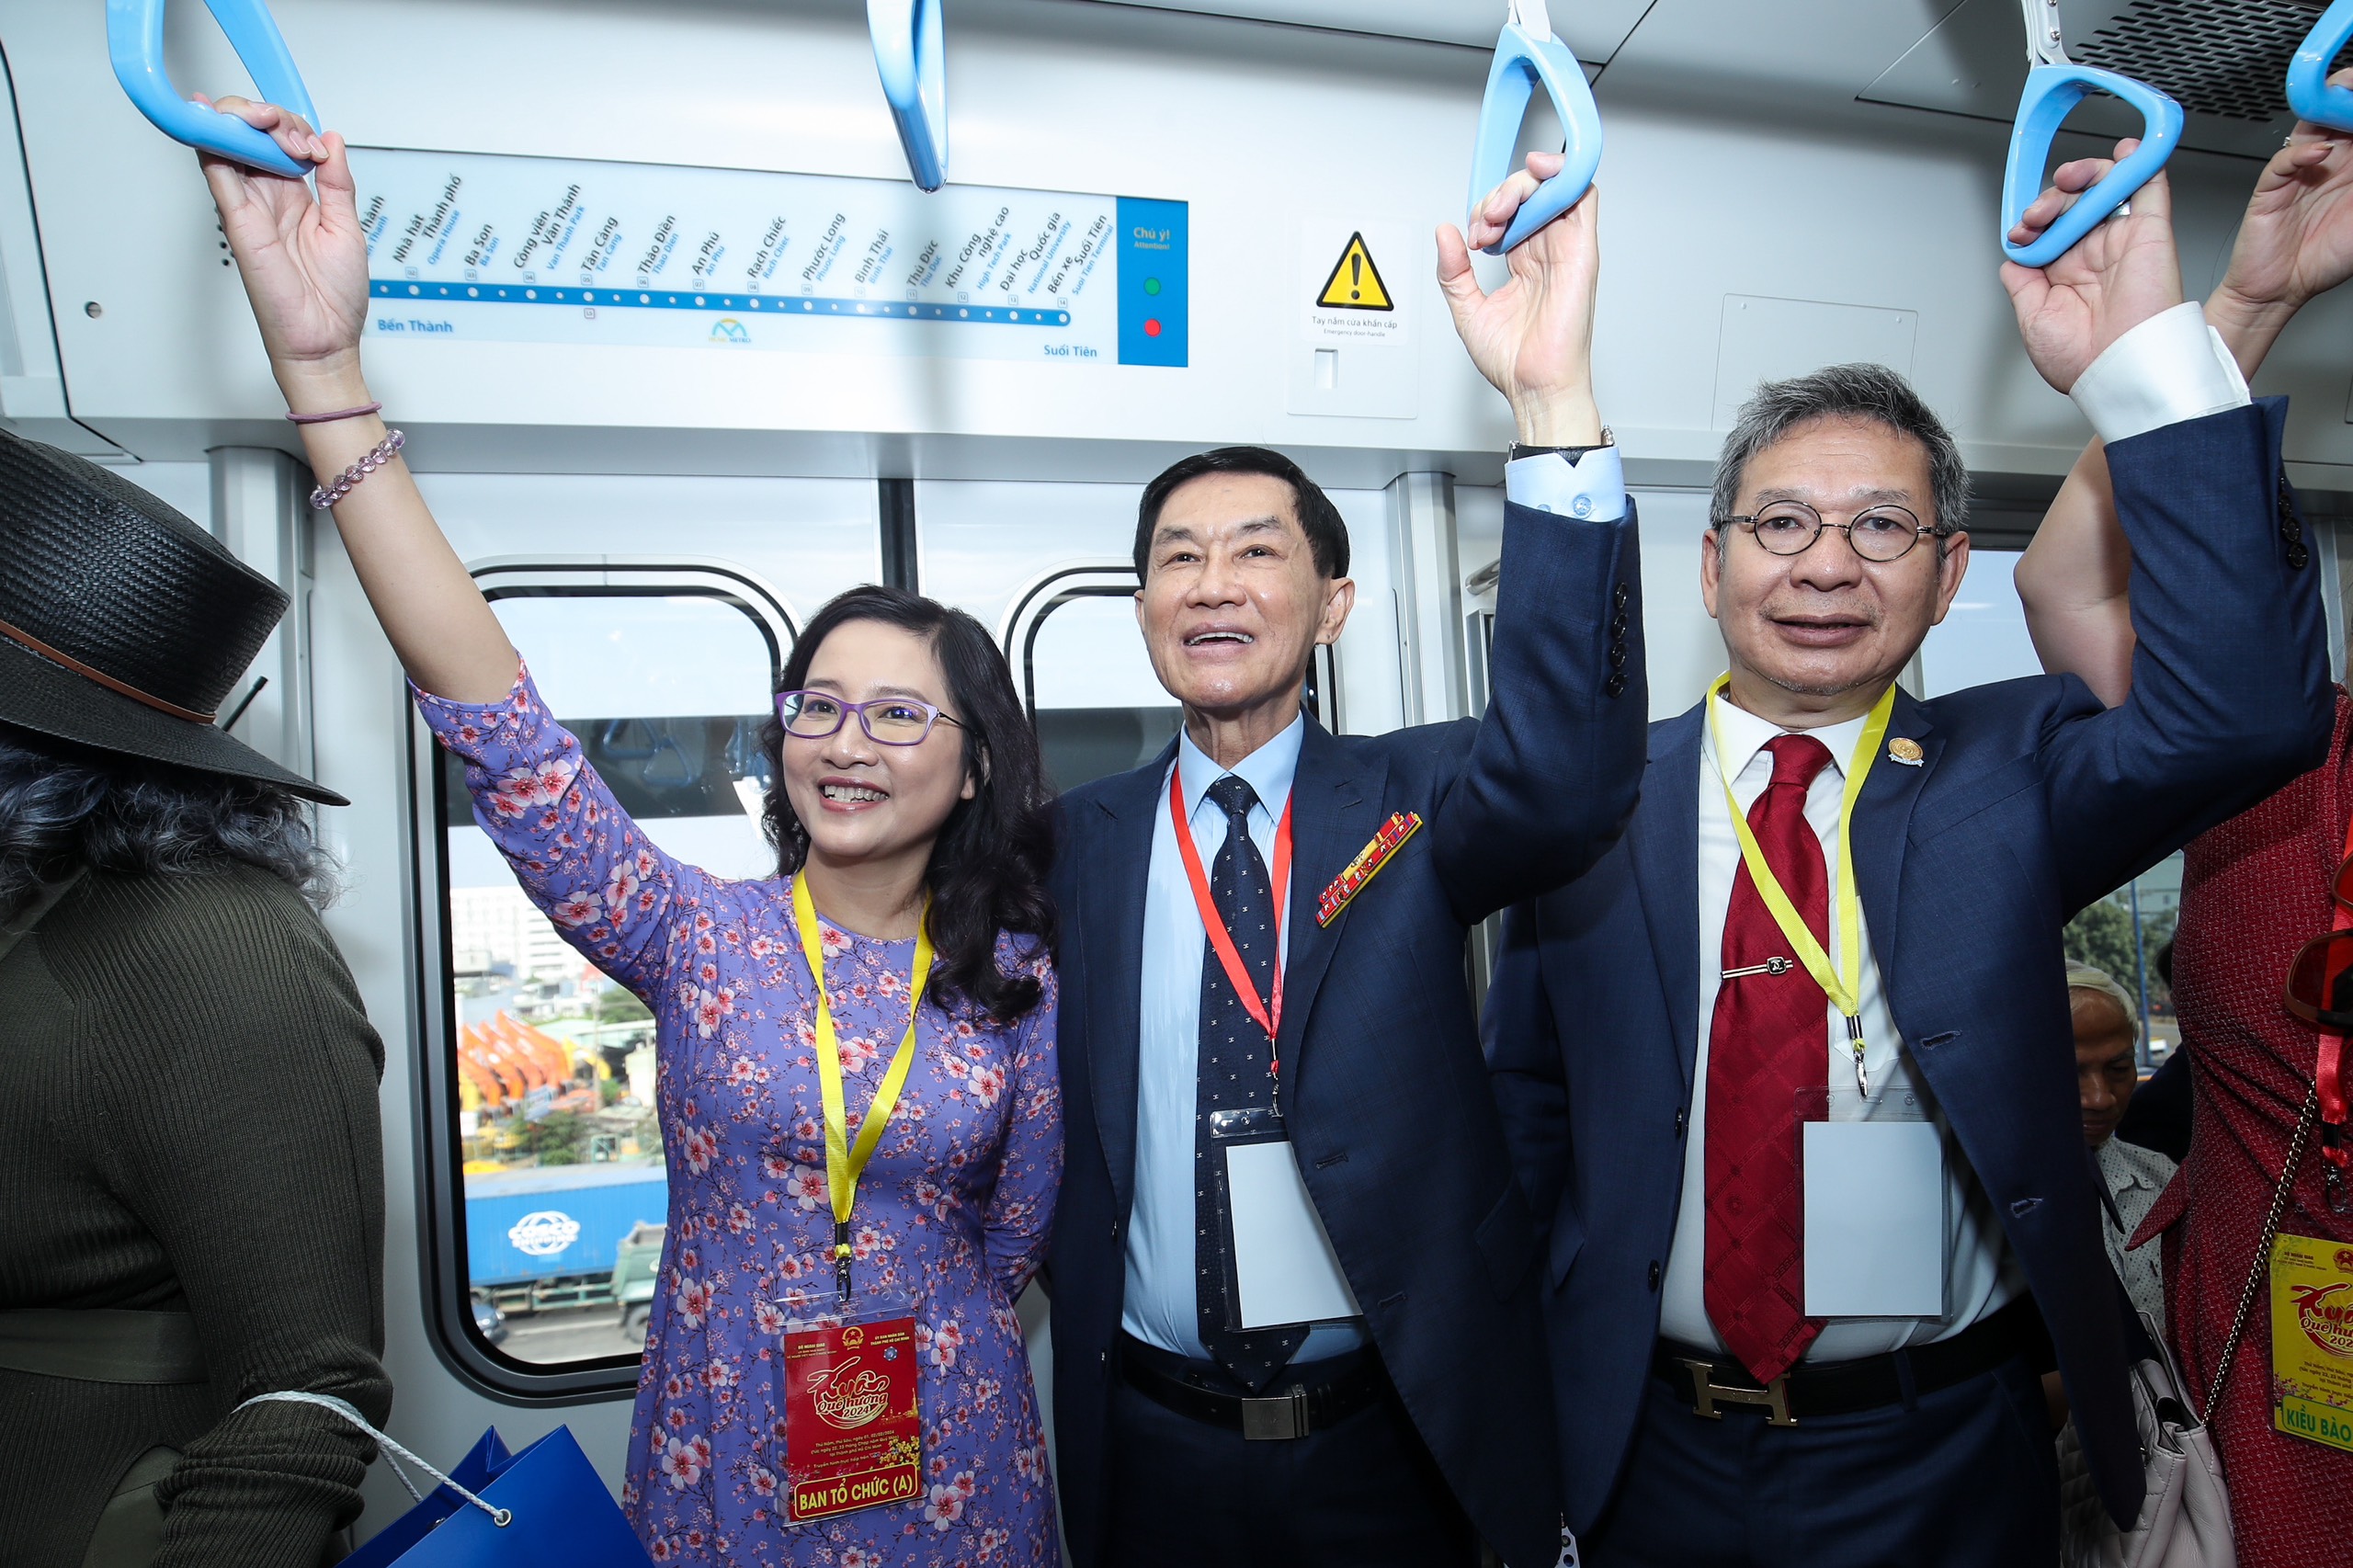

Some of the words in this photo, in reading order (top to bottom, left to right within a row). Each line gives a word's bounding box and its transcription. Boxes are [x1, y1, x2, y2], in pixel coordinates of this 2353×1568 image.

[421, 201, 449, 238] Thành
[444, 172, 461, 203] phố
[553, 184, 581, 221] Thánh
[392, 237, 413, 263] Nhà
[404, 213, 425, 236] hát
[427, 239, 445, 265] Opera
[441, 210, 460, 237] House
[464, 250, 481, 266] Ba
[473, 223, 493, 247] Son
[478, 255, 490, 267] Ba
[485, 236, 499, 254] Son
[514, 237, 538, 268] Công
[531, 210, 550, 236] viên
[546, 253, 560, 270] Van
[555, 226, 574, 253] Thanh
[570, 204, 585, 225] Park
[581, 249, 600, 272] Tân
[595, 216, 619, 247] Cảng
[595, 256, 609, 272] Tan
[605, 233, 622, 256] Cang
[637, 244, 660, 274] Thảo
[654, 214, 676, 244] Điền
[652, 254, 668, 274] Thao
[664, 233, 679, 253] Dien
[691, 256, 707, 275] An
[700, 232, 720, 256] Phú
[746, 249, 768, 278] Rạch
[763, 216, 786, 248] Chiếc
[802, 244, 828, 281] Phước
[822, 213, 846, 243] Long
[978, 227, 999, 258] nghệ
[995, 206, 1009, 227] cao
[1029, 233, 1051, 261] Quốc
[1047, 212, 1061, 232] gia
[1074, 239, 1093, 266] Suối
[1087, 214, 1107, 239] Tiên
[1133, 226, 1156, 240] Chú
[1158, 228, 1171, 243] ý!
[705, 263, 716, 276] An
[711, 244, 725, 262] Phu
[762, 258, 778, 279] Rach
[773, 235, 790, 257] Chiec
[815, 256, 834, 281] Phuoc
[829, 234, 847, 256] Long
[855, 257, 874, 283] Bình
[869, 228, 889, 255] Thái
[868, 266, 882, 284] Binh
[878, 246, 893, 264] Thai
[906, 265, 925, 287] Thủ
[919, 240, 938, 264] Đức
[920, 273, 933, 288] Thu
[929, 255, 941, 272] Duc
[945, 265, 963, 289] Khu
[959, 233, 982, 263] Công
[976, 270, 991, 290] High
[986, 251, 1002, 270] Tech
[997, 233, 1012, 251] Park
[999, 269, 1016, 291] Đại
[1010, 248, 1029, 271] học
[1028, 259, 1050, 294] National
[1046, 221, 1072, 260] University
[1047, 271, 1064, 294] Bến
[1062, 256, 1074, 271] xe
[1072, 277, 1086, 295] Suoi
[1082, 259, 1095, 277] Tien
[1091, 224, 1114, 259] Terminal
[378, 318, 404, 331] Bến
[408, 319, 453, 332] Thành
[1312, 316, 1325, 325] Tay
[1324, 328, 1352, 336] Emergency
[1044, 344, 1069, 356] Suối
[1073, 346, 1097, 357] Tiên
[2301, 1317, 2329, 1333] Quê
[2330, 1335, 2353, 1347] 202
[816, 1398, 844, 1415] Quê
[846, 1392, 889, 1407] hương
[843, 1406, 870, 1417] 2024
[2287, 1403, 2315, 1432] KIỀU
[2321, 1415, 2352, 1442] BÀO
[800, 1490, 826, 1510] BAN
[830, 1478, 848, 1505] TỔ
[851, 1476, 889, 1501] CHỨC
[893, 1474, 913, 1496] (A)
